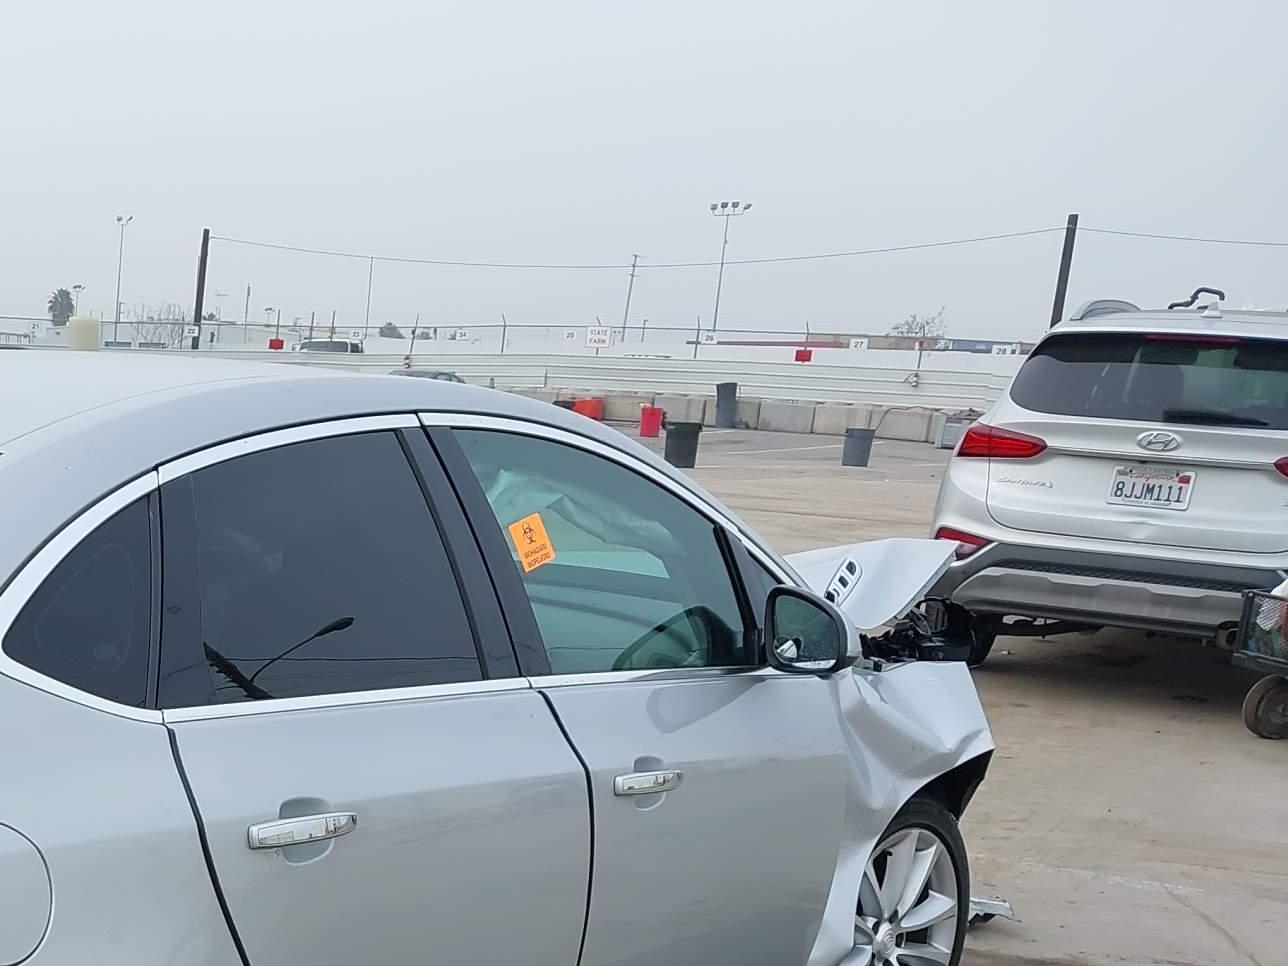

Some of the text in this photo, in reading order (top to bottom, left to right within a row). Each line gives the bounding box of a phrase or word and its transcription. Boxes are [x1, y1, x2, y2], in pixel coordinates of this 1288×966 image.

[589, 329, 609, 337] STATE
[589, 337, 607, 345] FARM
[704, 334, 714, 342] 26
[1114, 480, 1184, 503] 8JJM111
